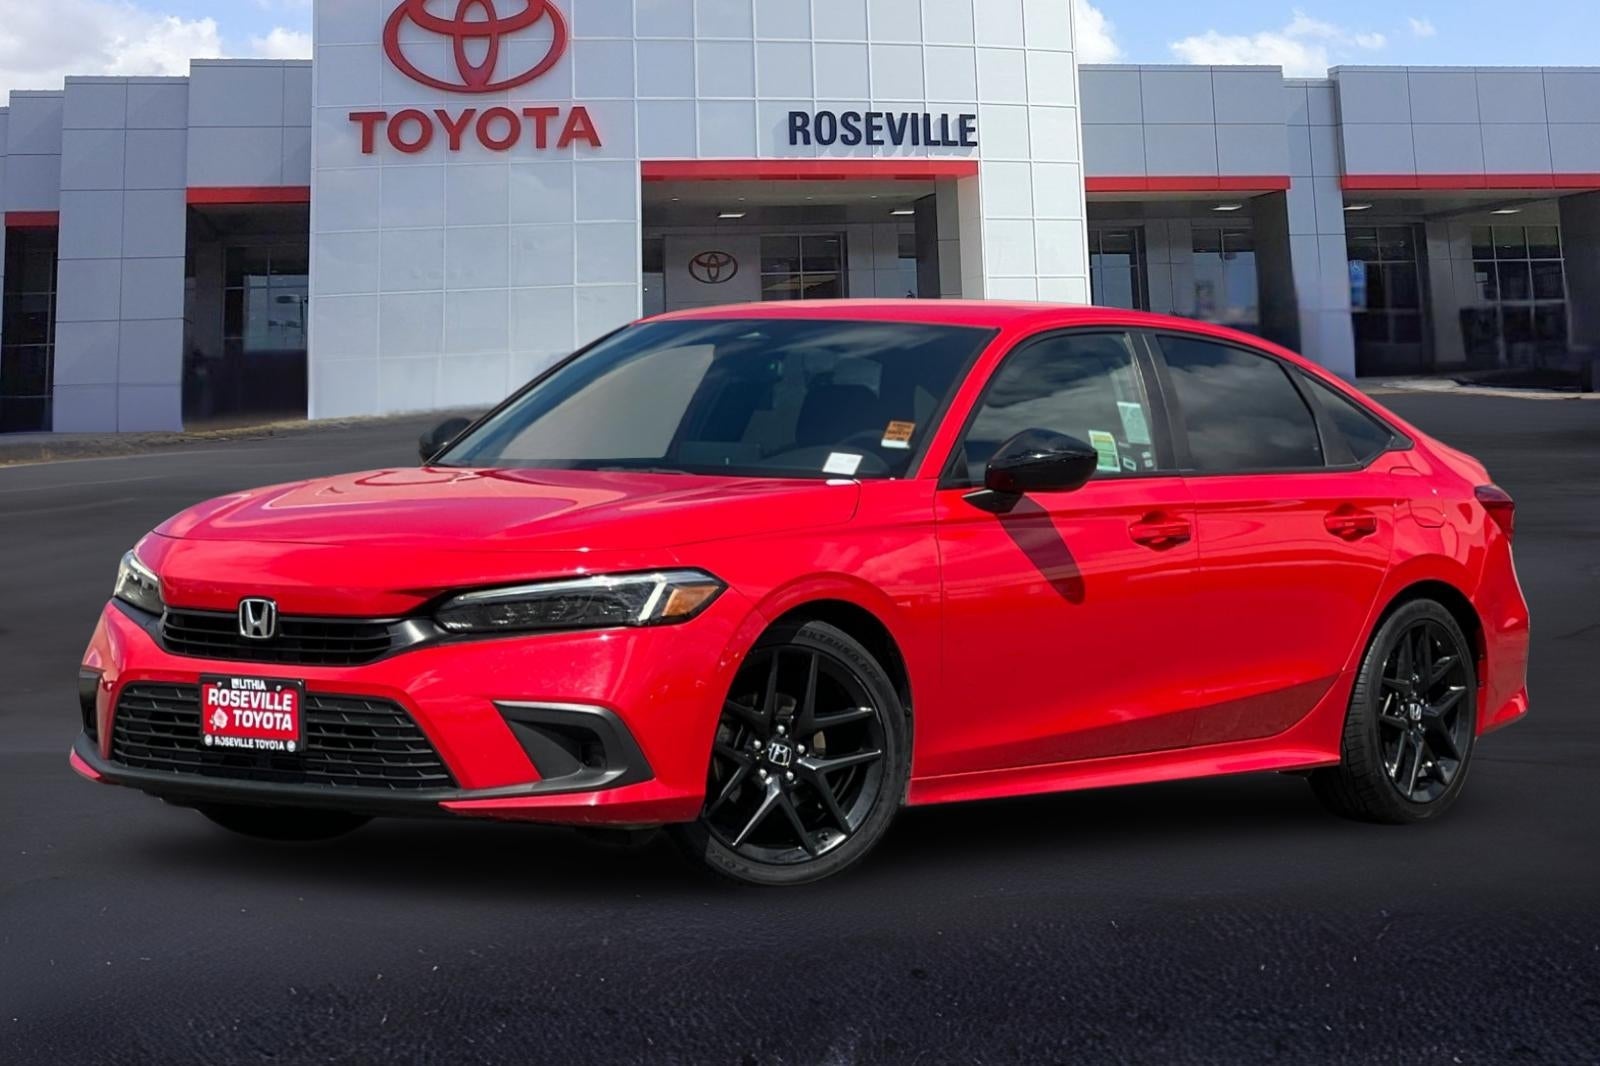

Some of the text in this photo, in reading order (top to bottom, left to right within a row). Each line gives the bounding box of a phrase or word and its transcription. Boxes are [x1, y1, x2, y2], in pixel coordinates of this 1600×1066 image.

[349, 106, 602, 153] TOYOTA
[788, 111, 978, 146] ROSEVILLE
[208, 688, 293, 711] ROSEVILLE
[233, 709, 293, 731] TOYOTA
